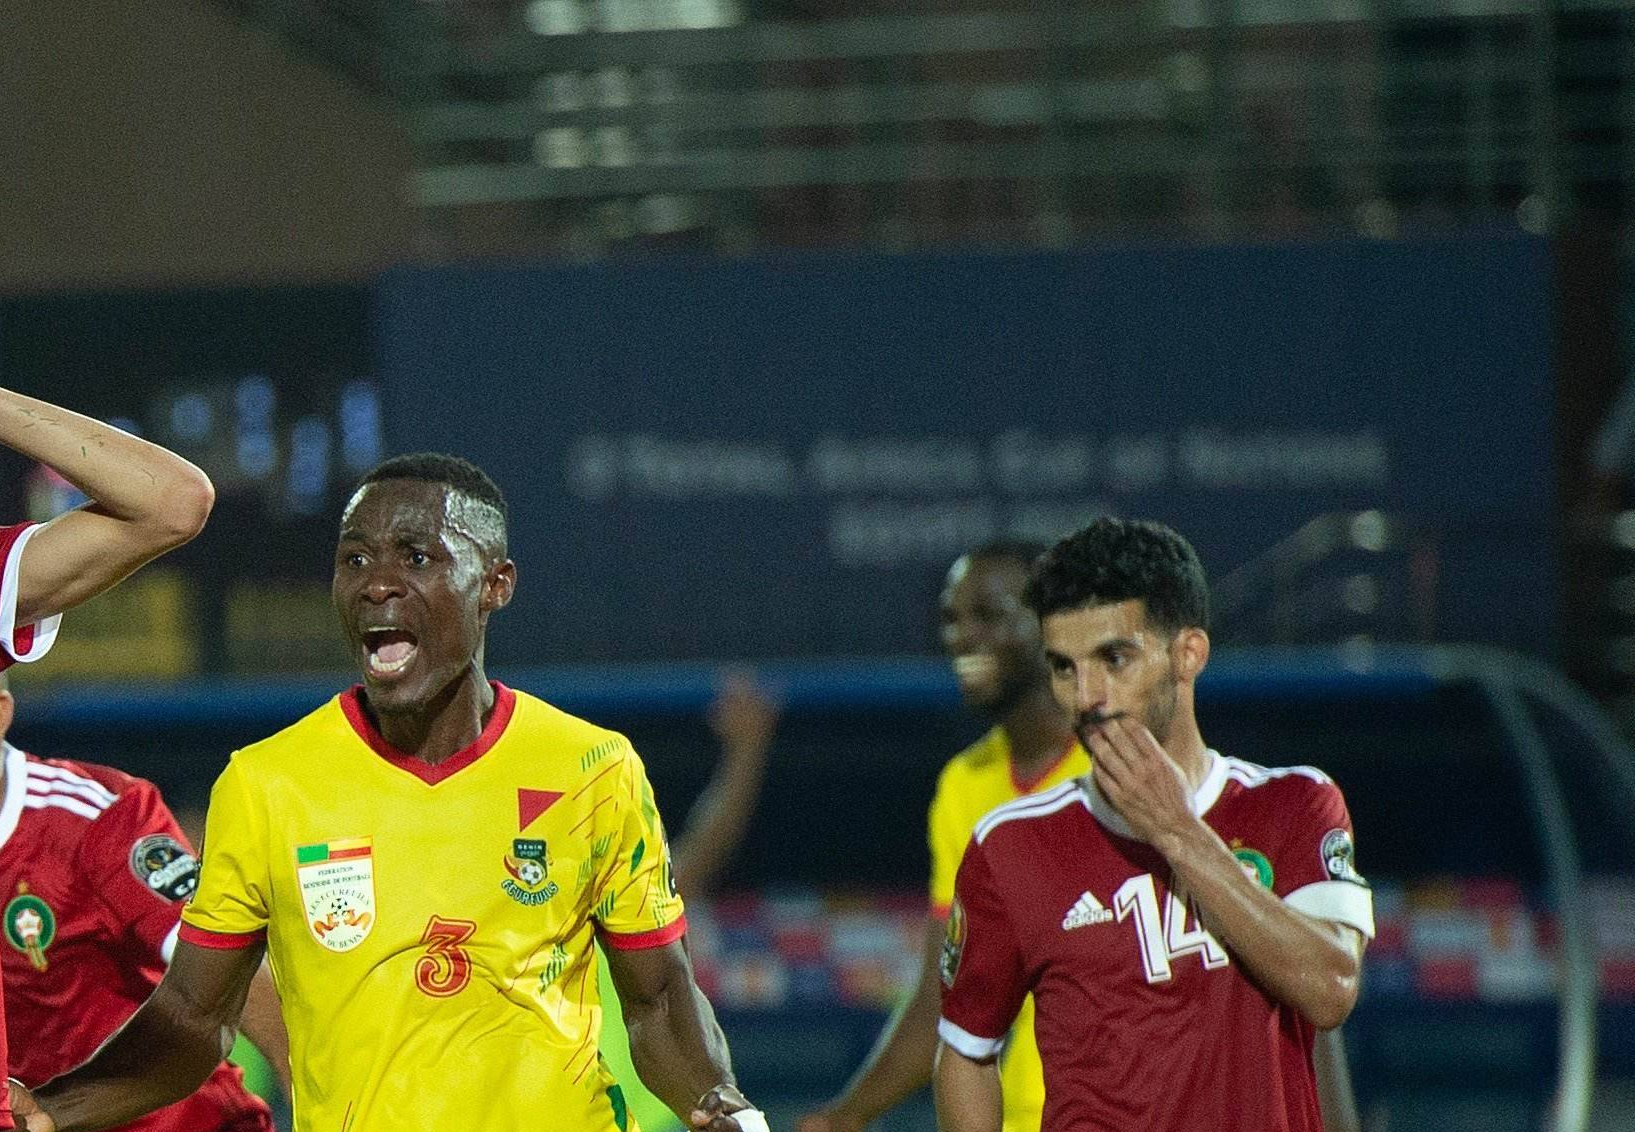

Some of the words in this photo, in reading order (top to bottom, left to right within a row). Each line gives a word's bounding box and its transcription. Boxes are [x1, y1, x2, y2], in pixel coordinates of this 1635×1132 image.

[414, 914, 478, 998] 3
[1062, 909, 1114, 931] adidas
[1112, 873, 1229, 984] 14
